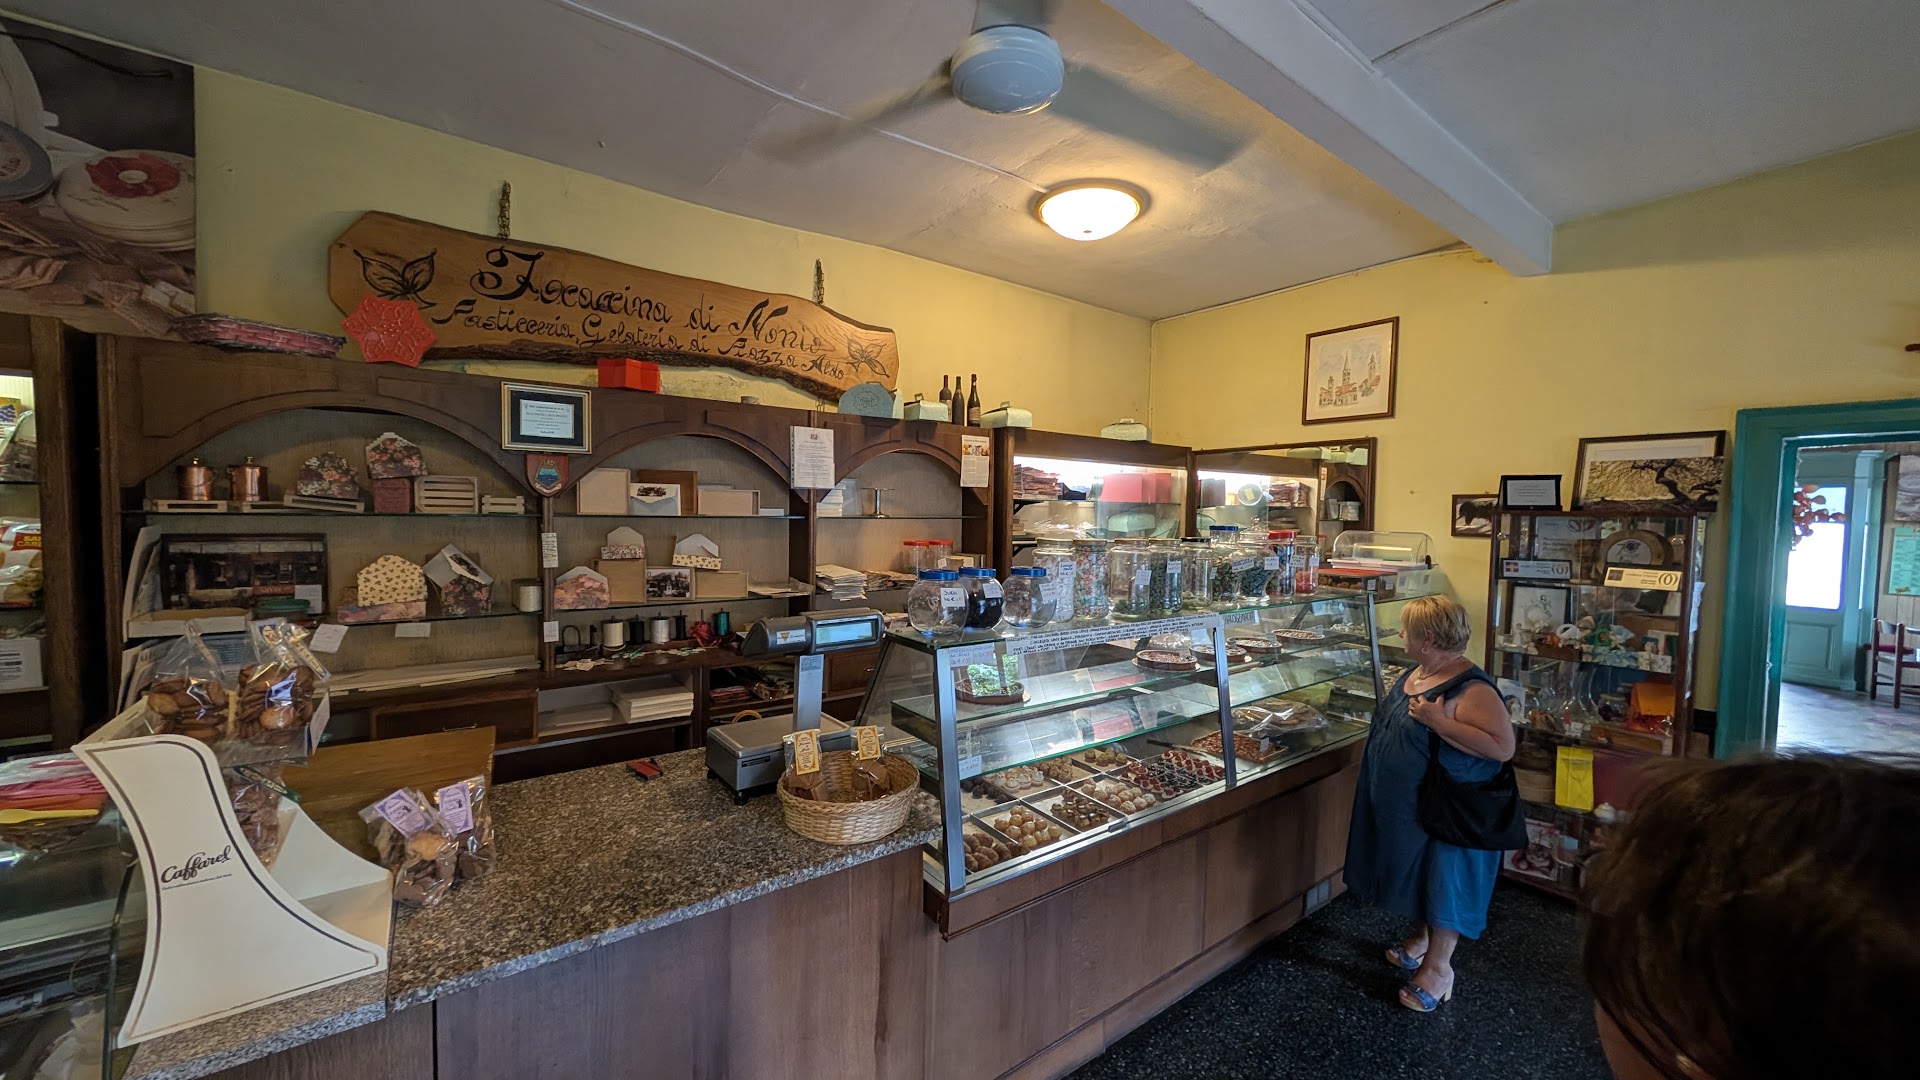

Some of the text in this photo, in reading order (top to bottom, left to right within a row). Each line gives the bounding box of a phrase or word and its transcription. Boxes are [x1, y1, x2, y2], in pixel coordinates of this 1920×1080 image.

[431, 299, 845, 380] Pasticceria, Gelateria di Piazza Aldo
[469, 246, 823, 354] Focaccina di Nonio
[161, 845, 231, 883] Caffarel
